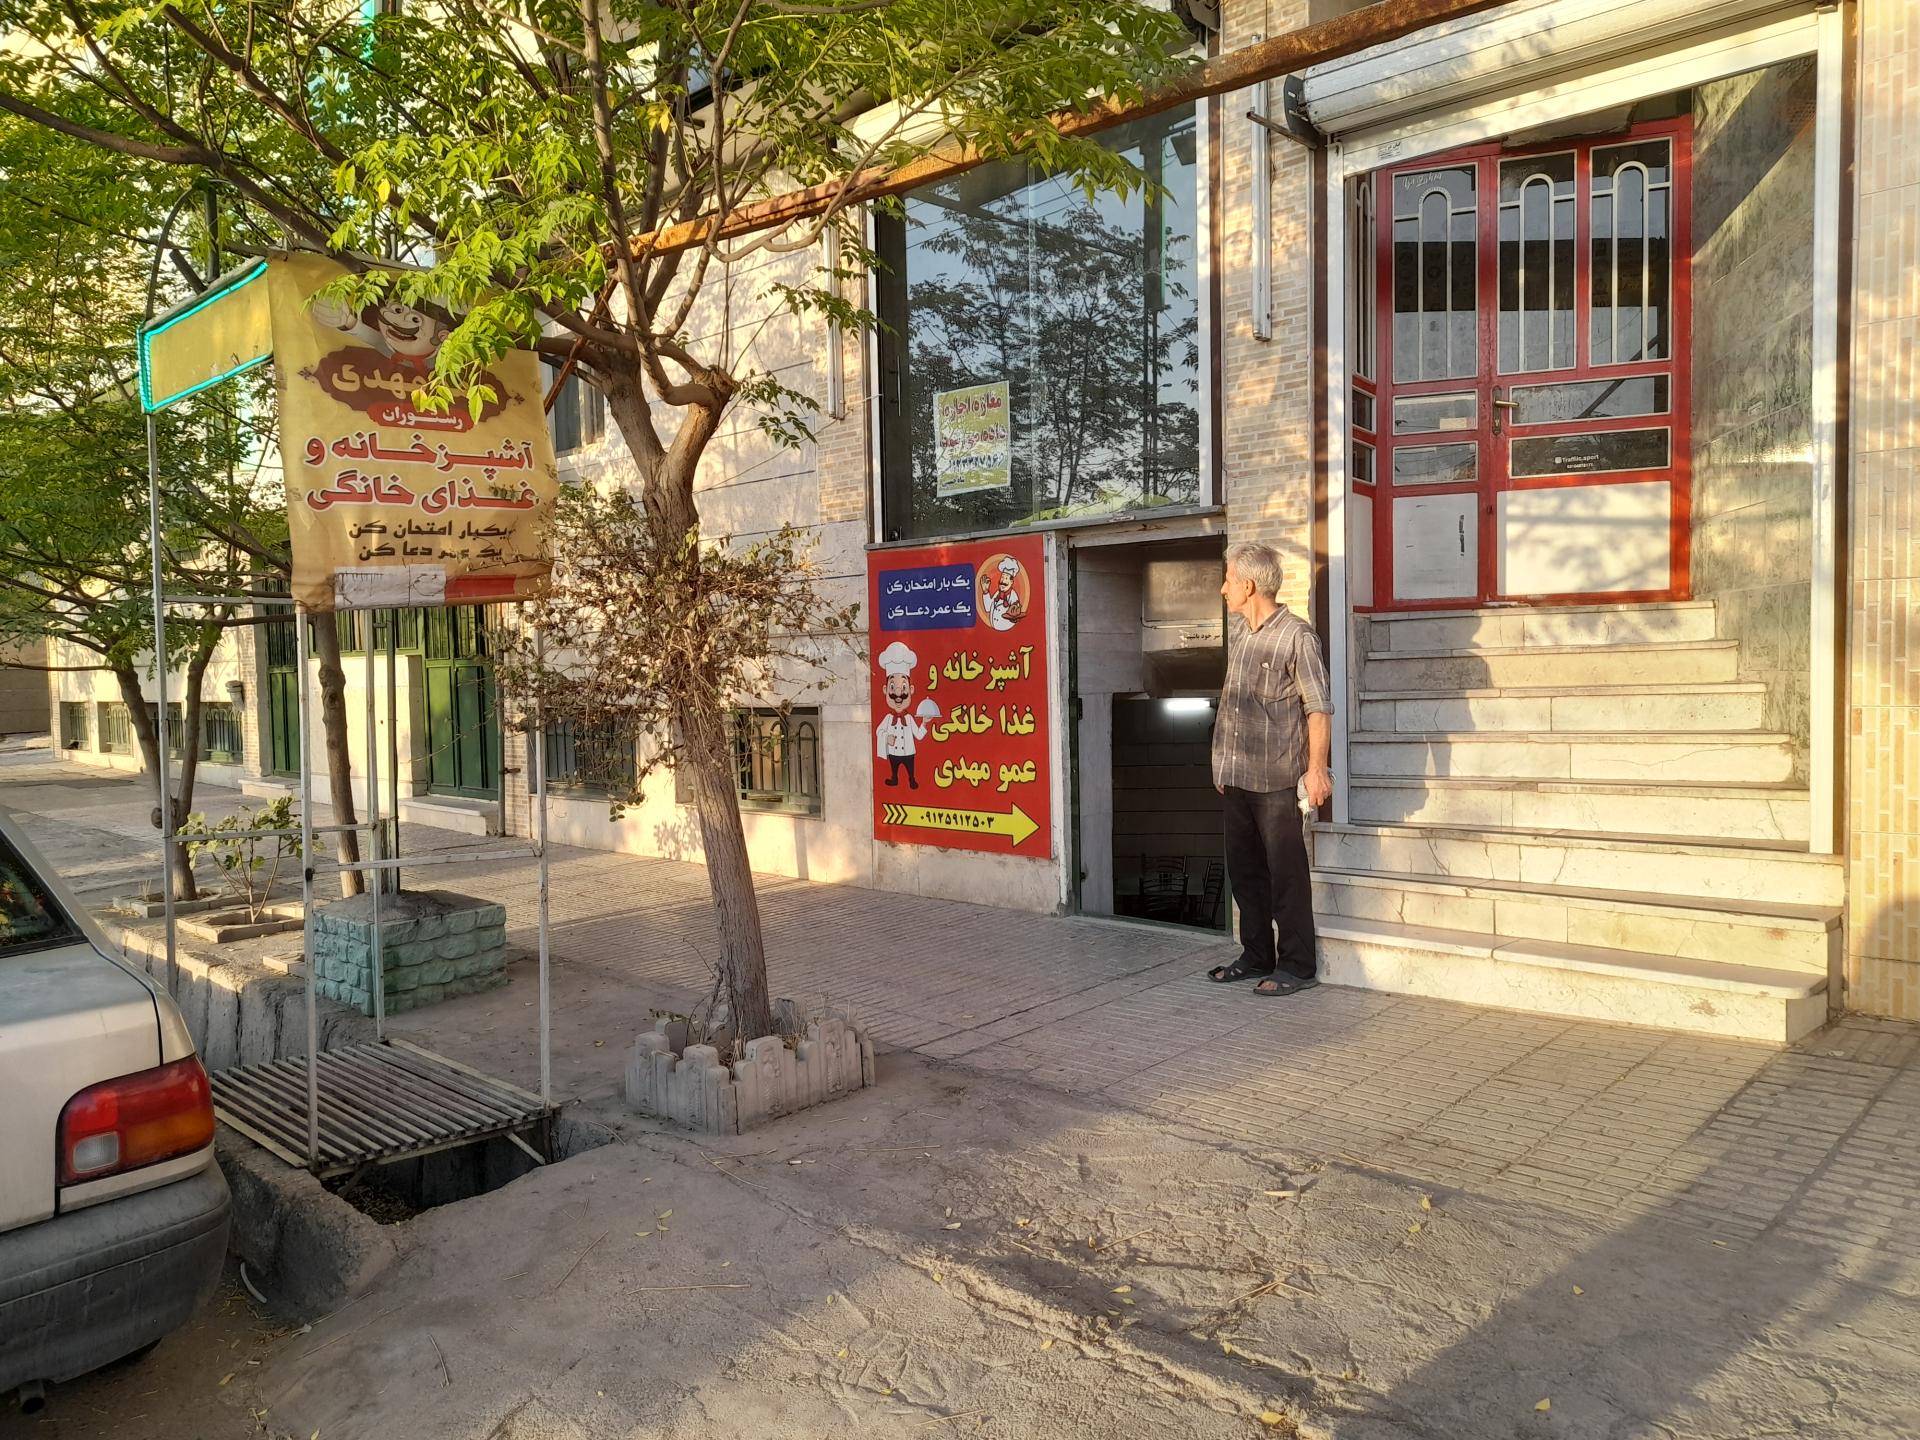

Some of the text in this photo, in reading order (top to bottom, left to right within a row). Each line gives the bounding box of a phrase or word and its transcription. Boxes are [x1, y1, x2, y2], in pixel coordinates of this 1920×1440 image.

[382, 405, 463, 429] رستوران
[304, 431, 535, 481] آشپزخانه و
[306, 469, 540, 515] غذای خانگی
[348, 518, 508, 541] یکبار امتحان کن
[359, 542, 396, 561] کن
[402, 540, 433, 557] دعا
[886, 574, 971, 595] یک بار امتحان کن
[887, 601, 972, 620] یک عمر دعا کن
[927, 663, 938, 691] و
[931, 703, 1036, 742] غذا خانگی
[934, 754, 1037, 793] عمو مهدی
[919, 810, 995, 829] ۰۹۱۲۵۹۱۲۵۰۳
